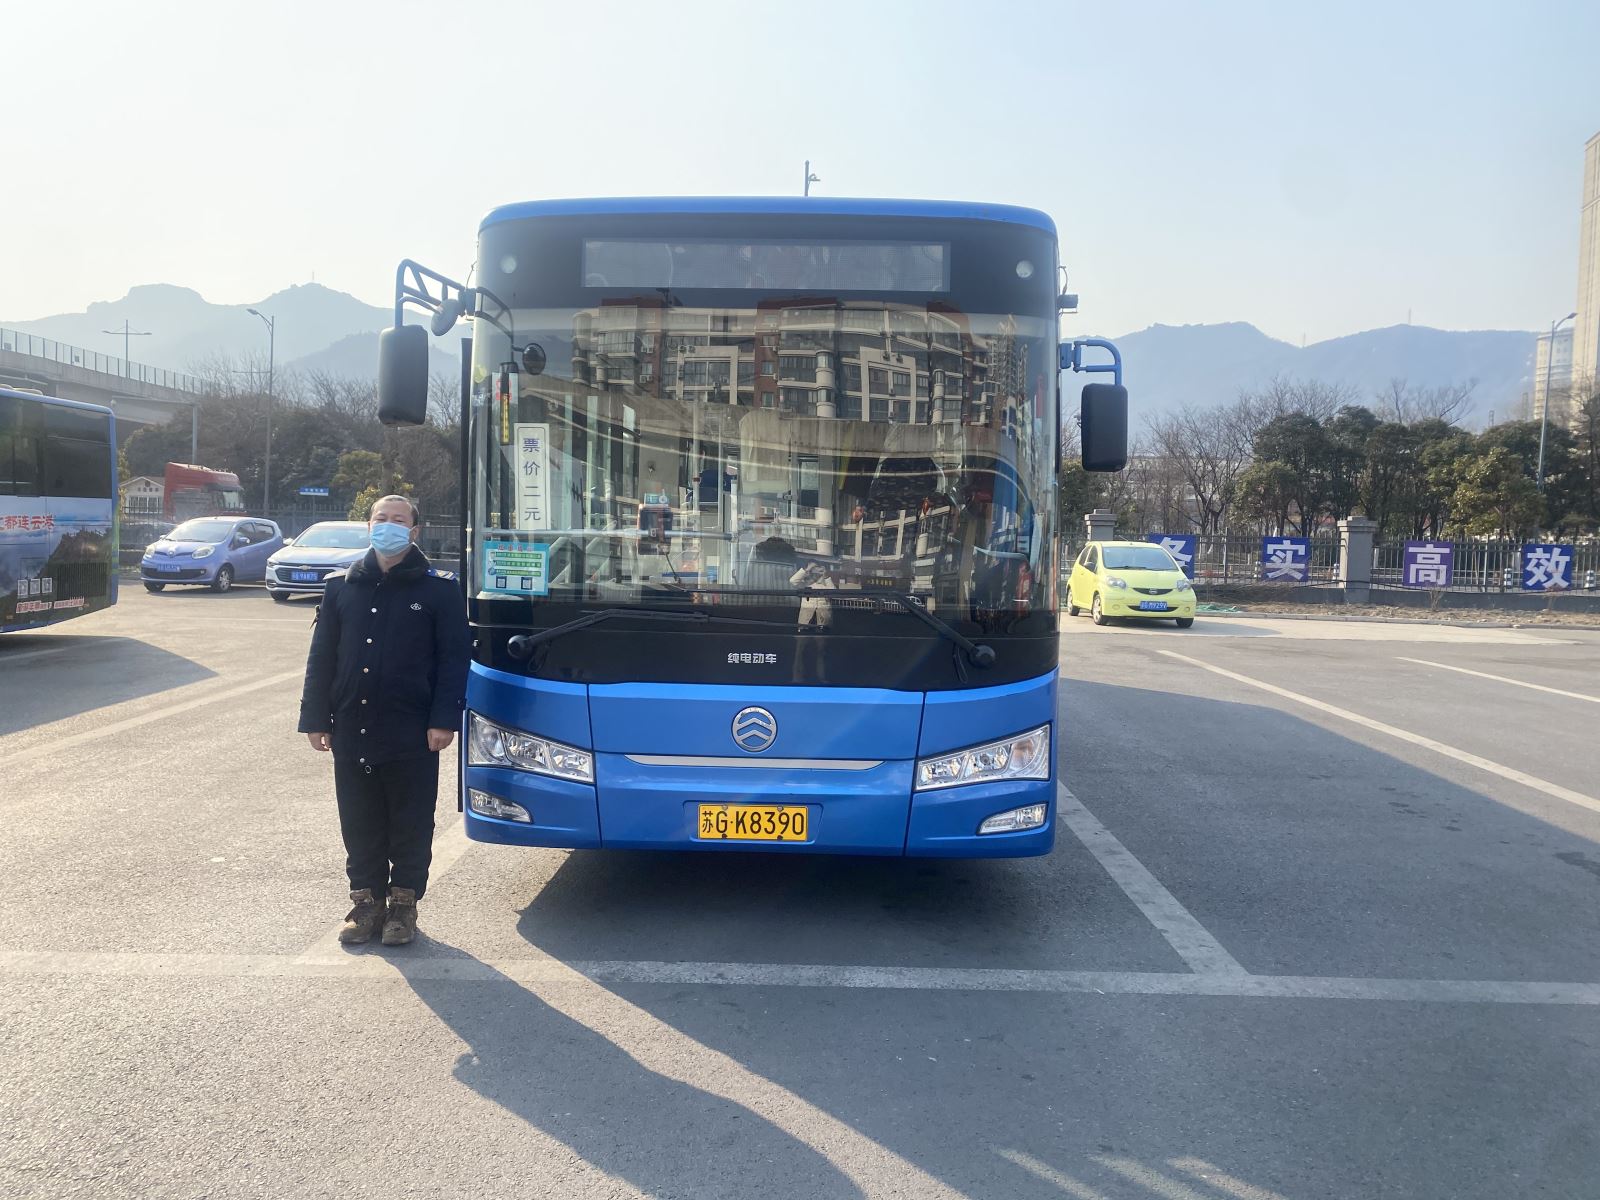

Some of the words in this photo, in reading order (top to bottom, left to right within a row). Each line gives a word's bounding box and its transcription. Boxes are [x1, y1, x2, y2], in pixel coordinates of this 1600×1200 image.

[522, 437, 541, 521] 票价二元
[1265, 539, 1305, 580] 实
[1408, 544, 1450, 585] 高
[1525, 547, 1570, 587] 效
[727, 652, 777, 664] 纯电动车
